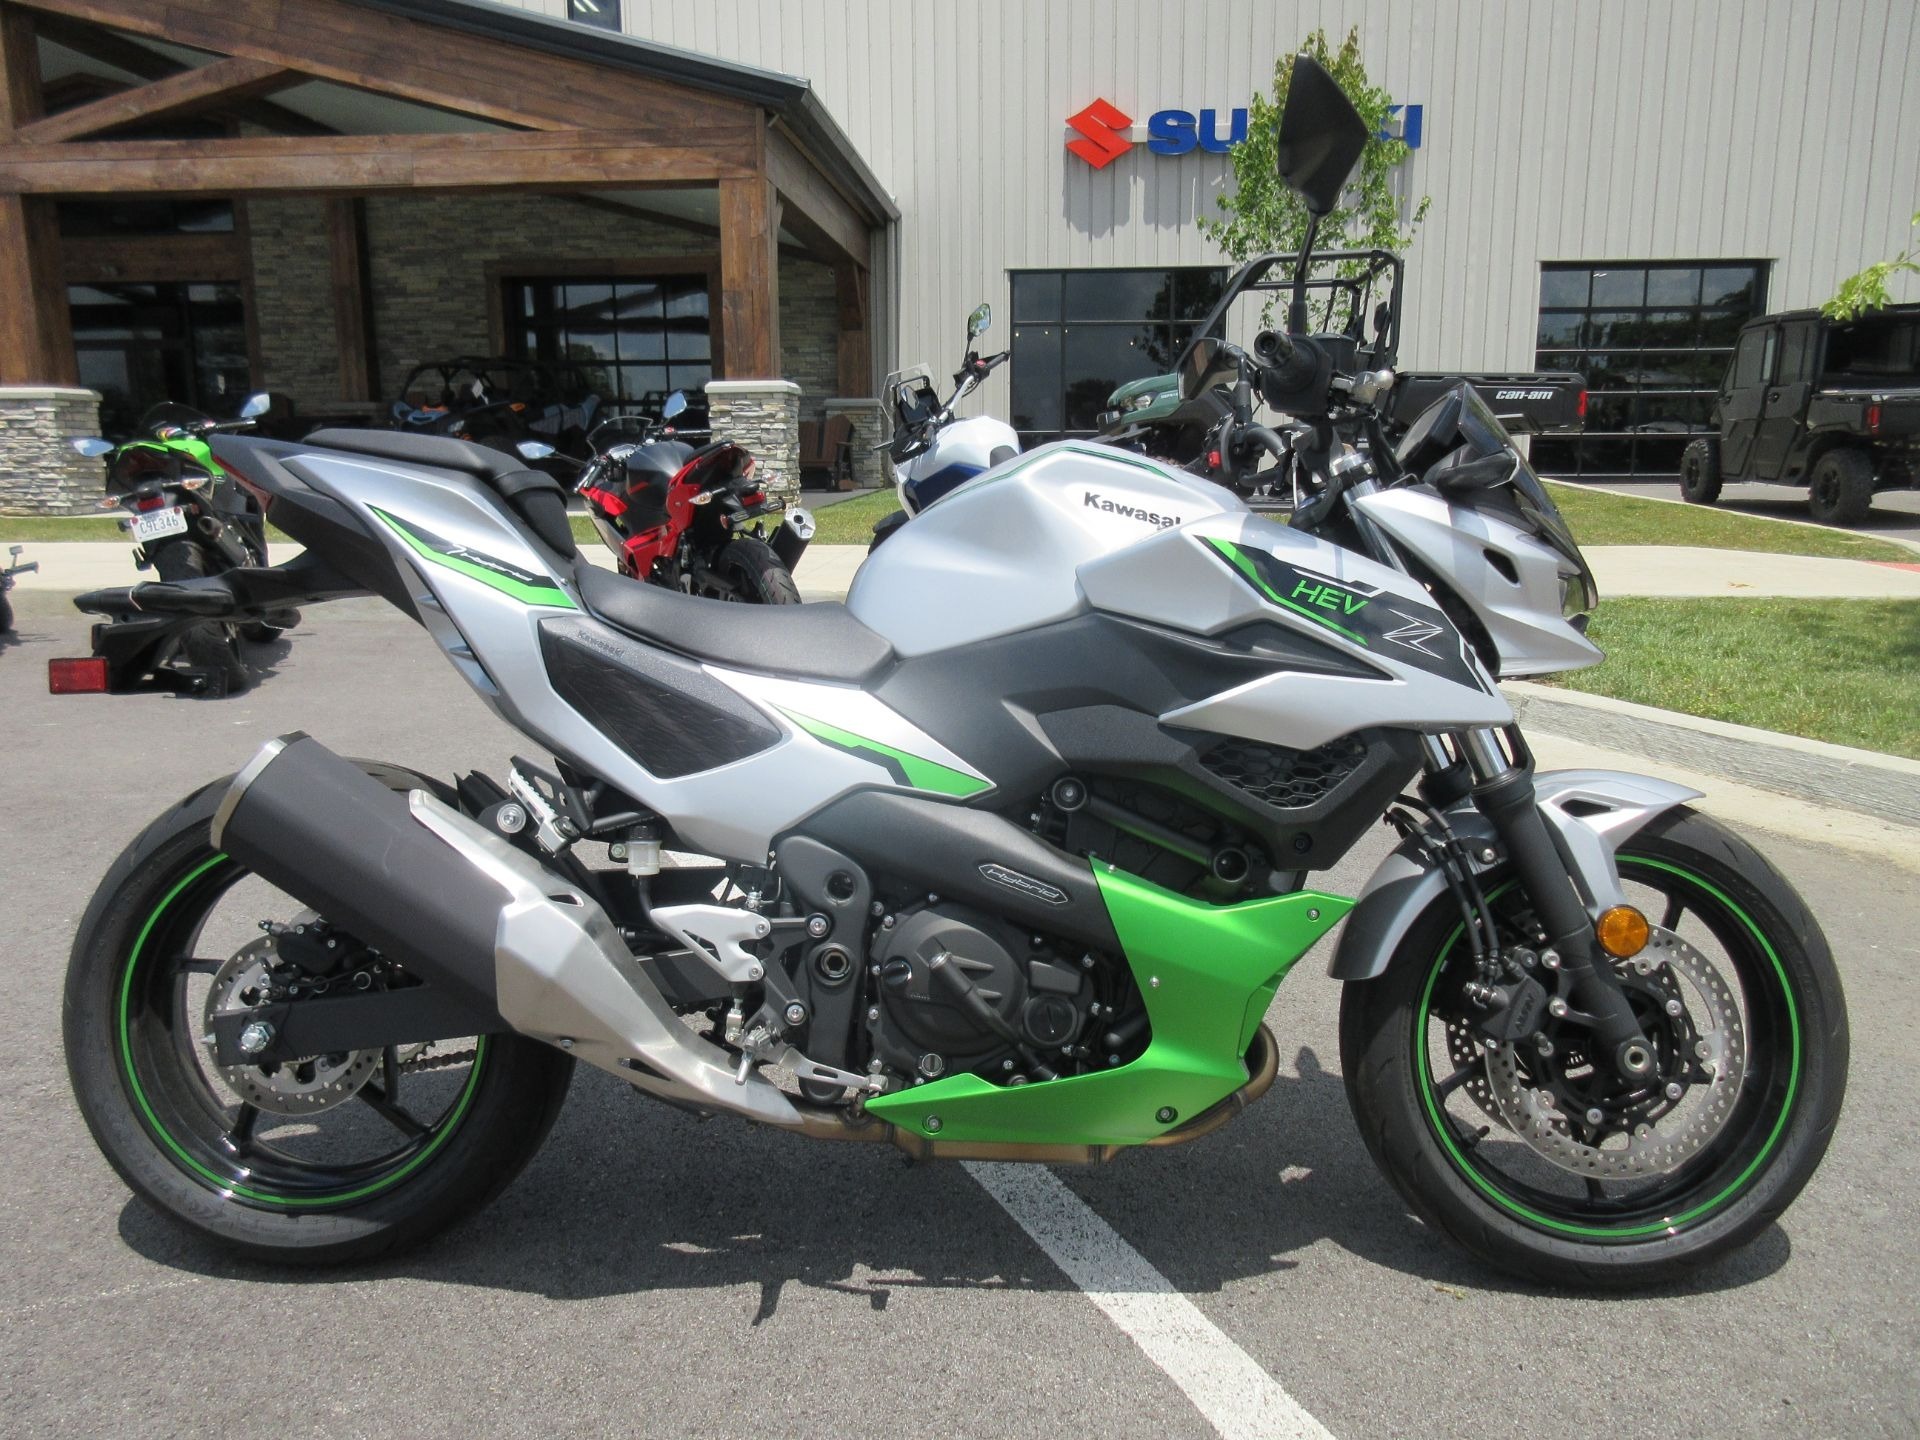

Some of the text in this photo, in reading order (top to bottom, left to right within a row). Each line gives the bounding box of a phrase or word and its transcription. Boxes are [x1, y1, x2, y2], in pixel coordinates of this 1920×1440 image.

[1147, 104, 1424, 155] SUI
[1495, 390, 1553, 400] can-am
[1083, 491, 1181, 528] Kawasa
[1291, 579, 1369, 615] HEV
[986, 868, 1060, 899] Hybrid
